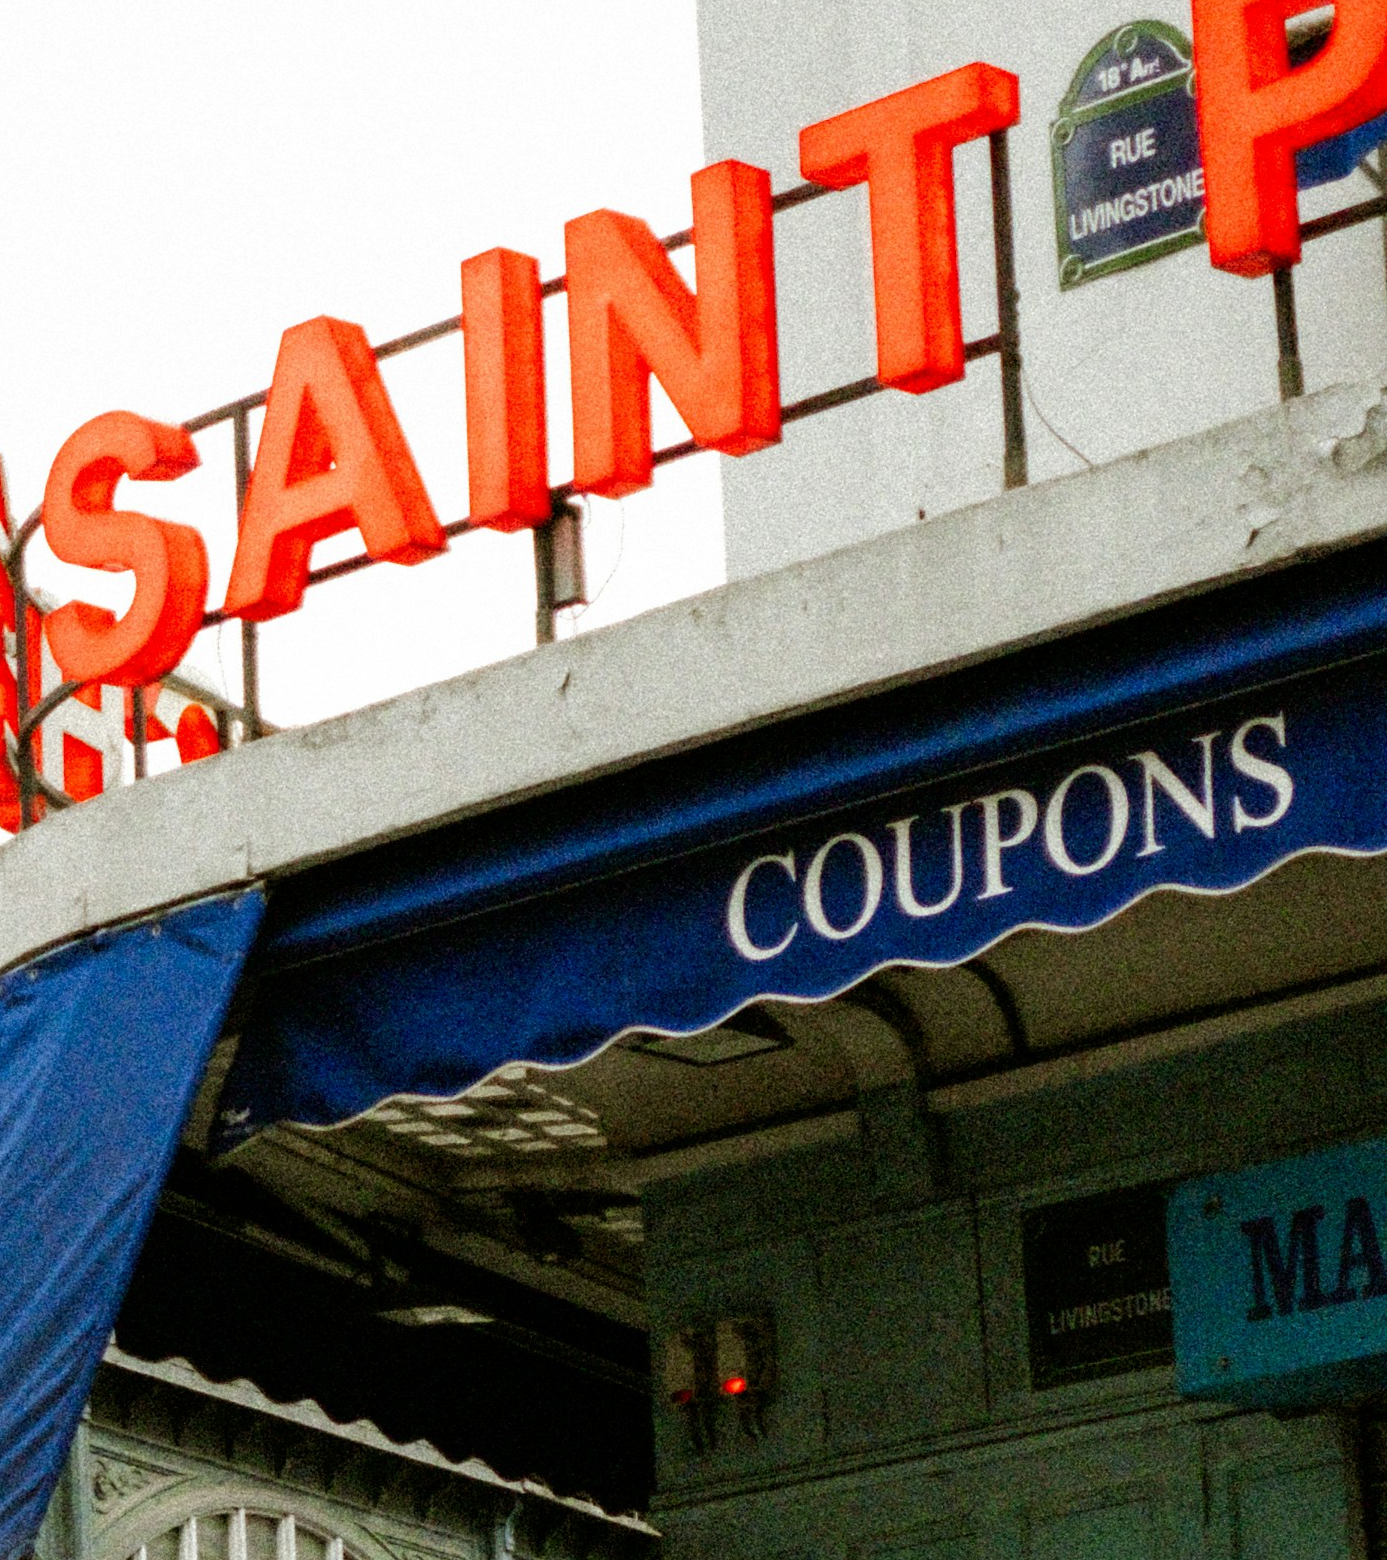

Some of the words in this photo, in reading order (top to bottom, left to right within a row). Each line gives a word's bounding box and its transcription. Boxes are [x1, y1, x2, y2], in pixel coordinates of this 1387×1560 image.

[1109, 127, 1157, 169] RUE
[1070, 170, 1205, 241] LIVINGSTONE
[44, 62, 1019, 687] SAINT
[726, 715, 1297, 964] COUPONS
[1086, 1238, 1127, 1269] RUE
